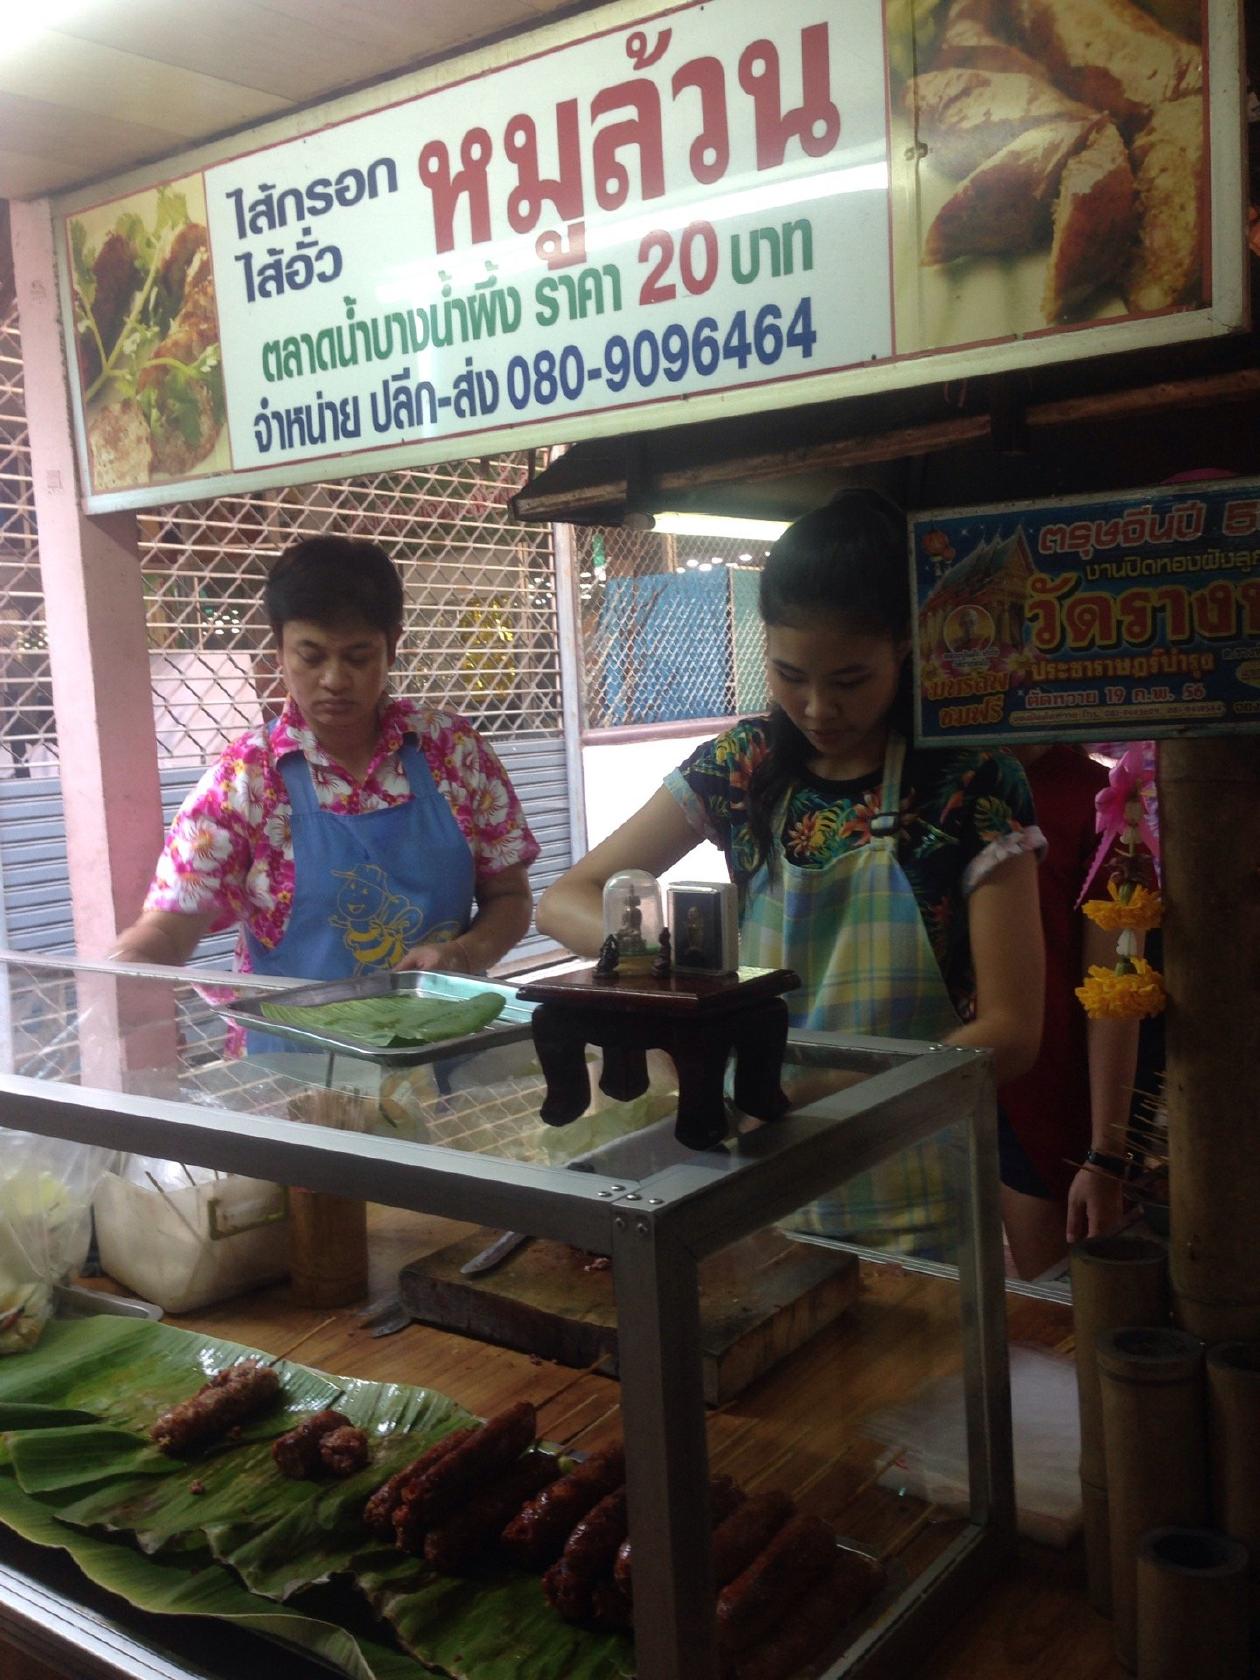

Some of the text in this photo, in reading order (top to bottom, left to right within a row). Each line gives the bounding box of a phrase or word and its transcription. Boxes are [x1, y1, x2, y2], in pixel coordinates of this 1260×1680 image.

[226, 157, 397, 241] ไส้กรอก
[418, 21, 841, 271] หมูล้วน
[235, 227, 343, 303] ไส้อั่ว
[261, 219, 813, 383] ตลาดน้ำบางน้ำผึ้ง ราคา 20 บาท
[253, 297, 817, 454] จำหน่าย ปลีก-ส่ง 080-9096464
[1104, 685, 1126, 704] 19
